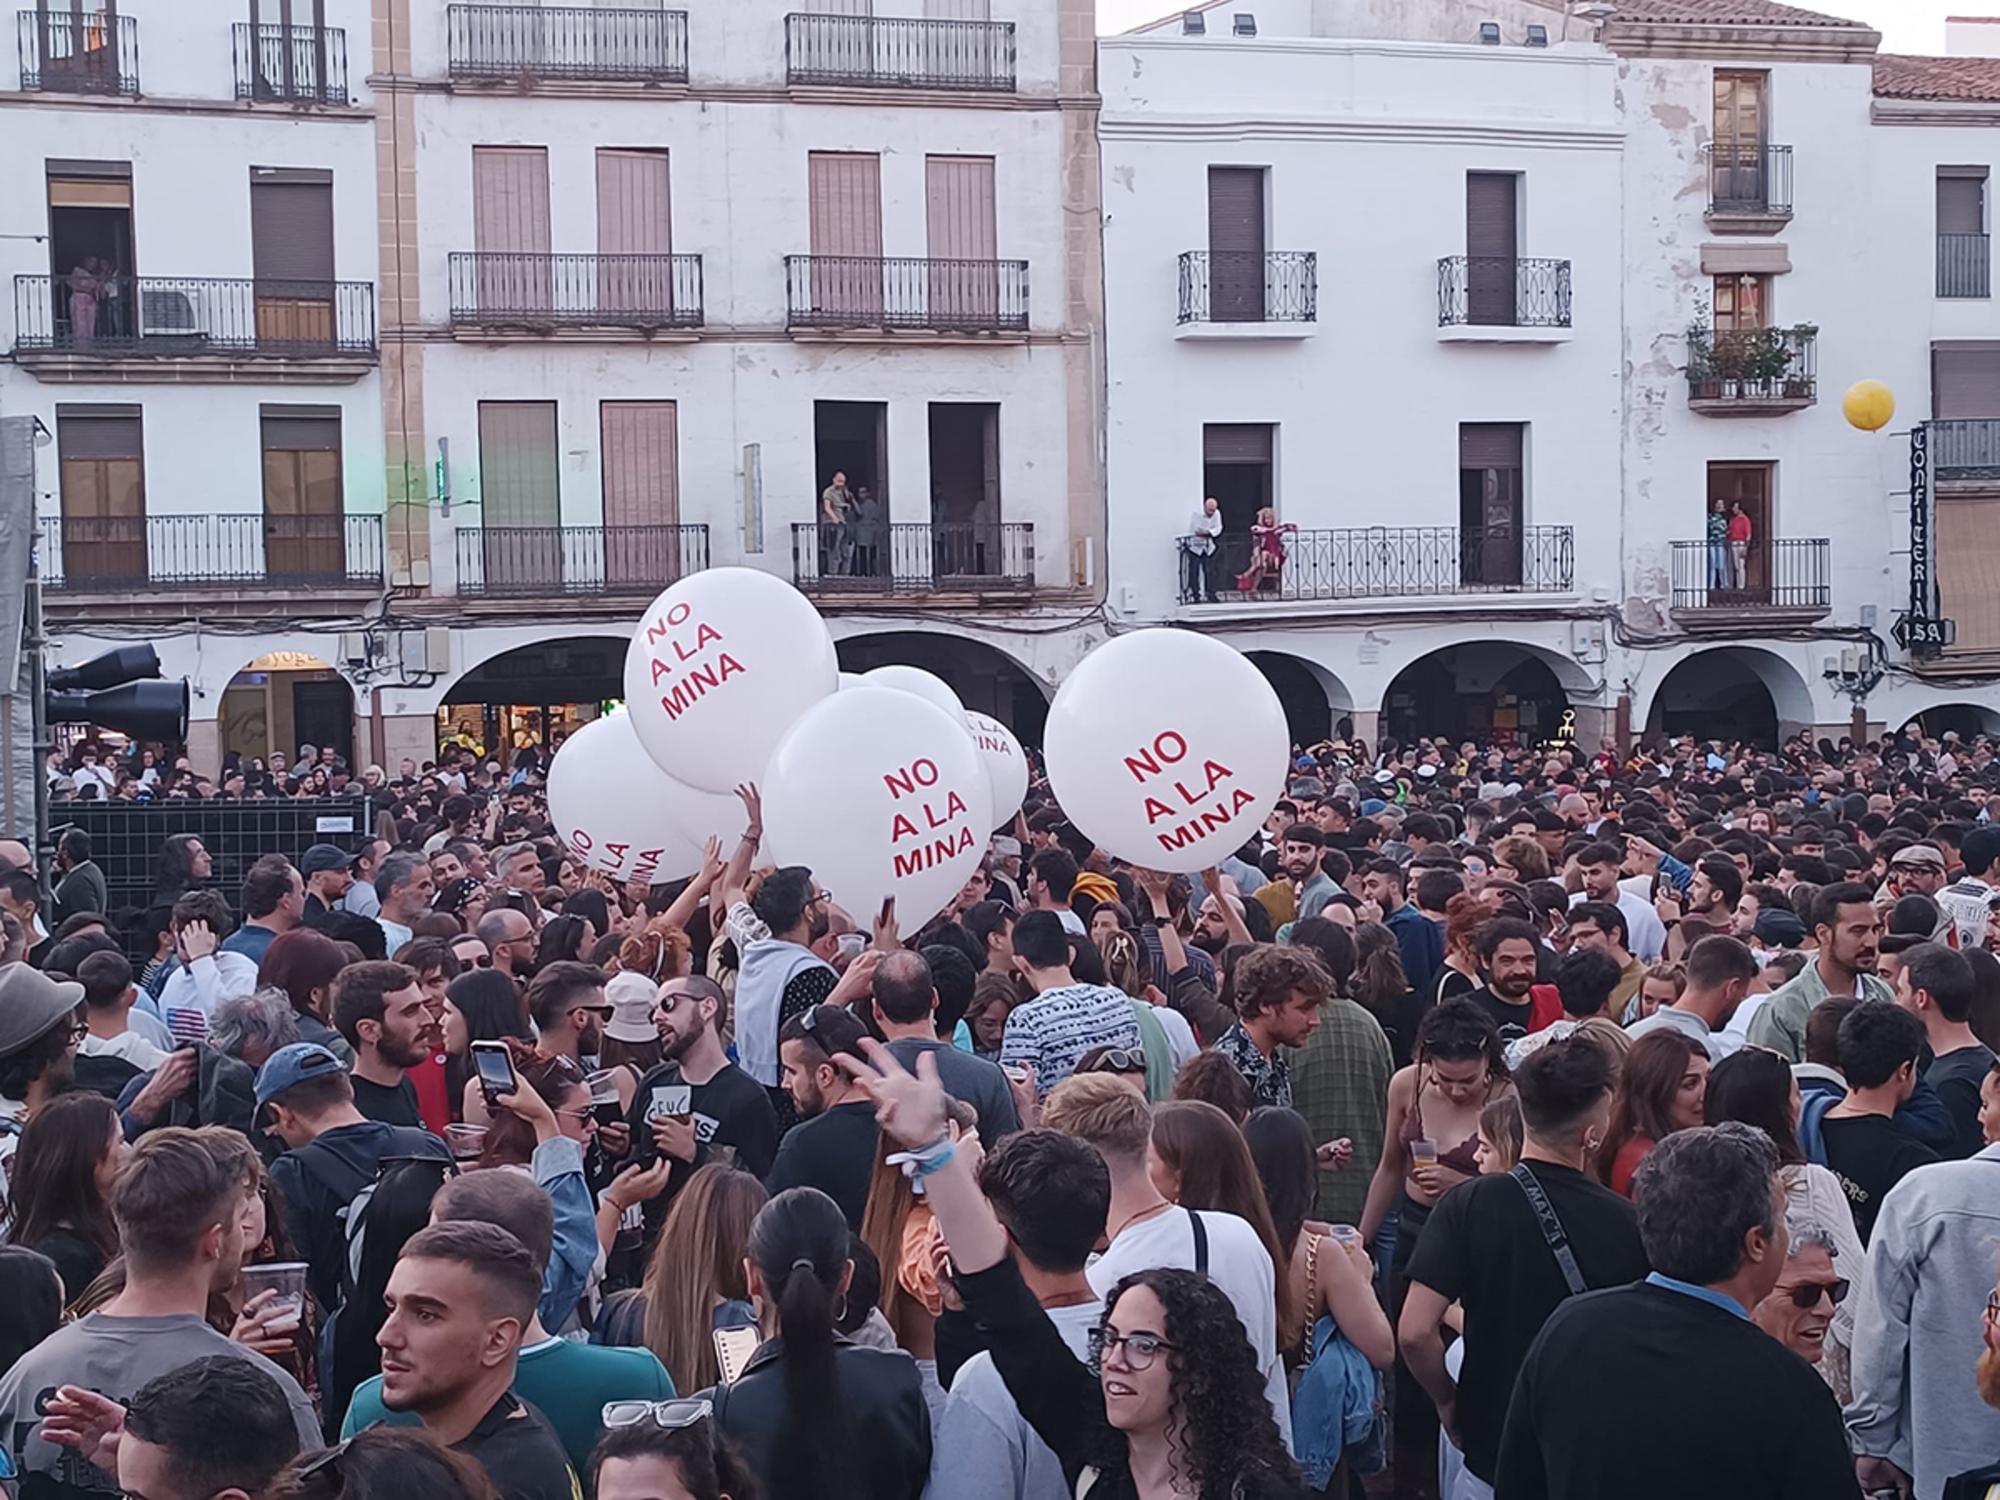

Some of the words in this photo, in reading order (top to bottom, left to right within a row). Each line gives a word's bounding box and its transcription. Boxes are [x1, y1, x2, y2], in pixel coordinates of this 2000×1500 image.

[1911, 430, 1926, 618] CONFITERIA
[647, 603, 691, 646] NO
[651, 657, 672, 687] A
[672, 622, 723, 662] LA
[661, 652, 746, 721] MINA
[973, 735, 1012, 757] INA
[1123, 730, 1188, 783] NO
[883, 758, 939, 800] NO
[1144, 797, 1177, 825] A
[1173, 759, 1234, 805] LA
[892, 813, 919, 843] A
[923, 791, 967, 829] LA
[1156, 788, 1256, 852] MINA
[599, 843, 630, 869] LA
[893, 826, 976, 878] MINA
